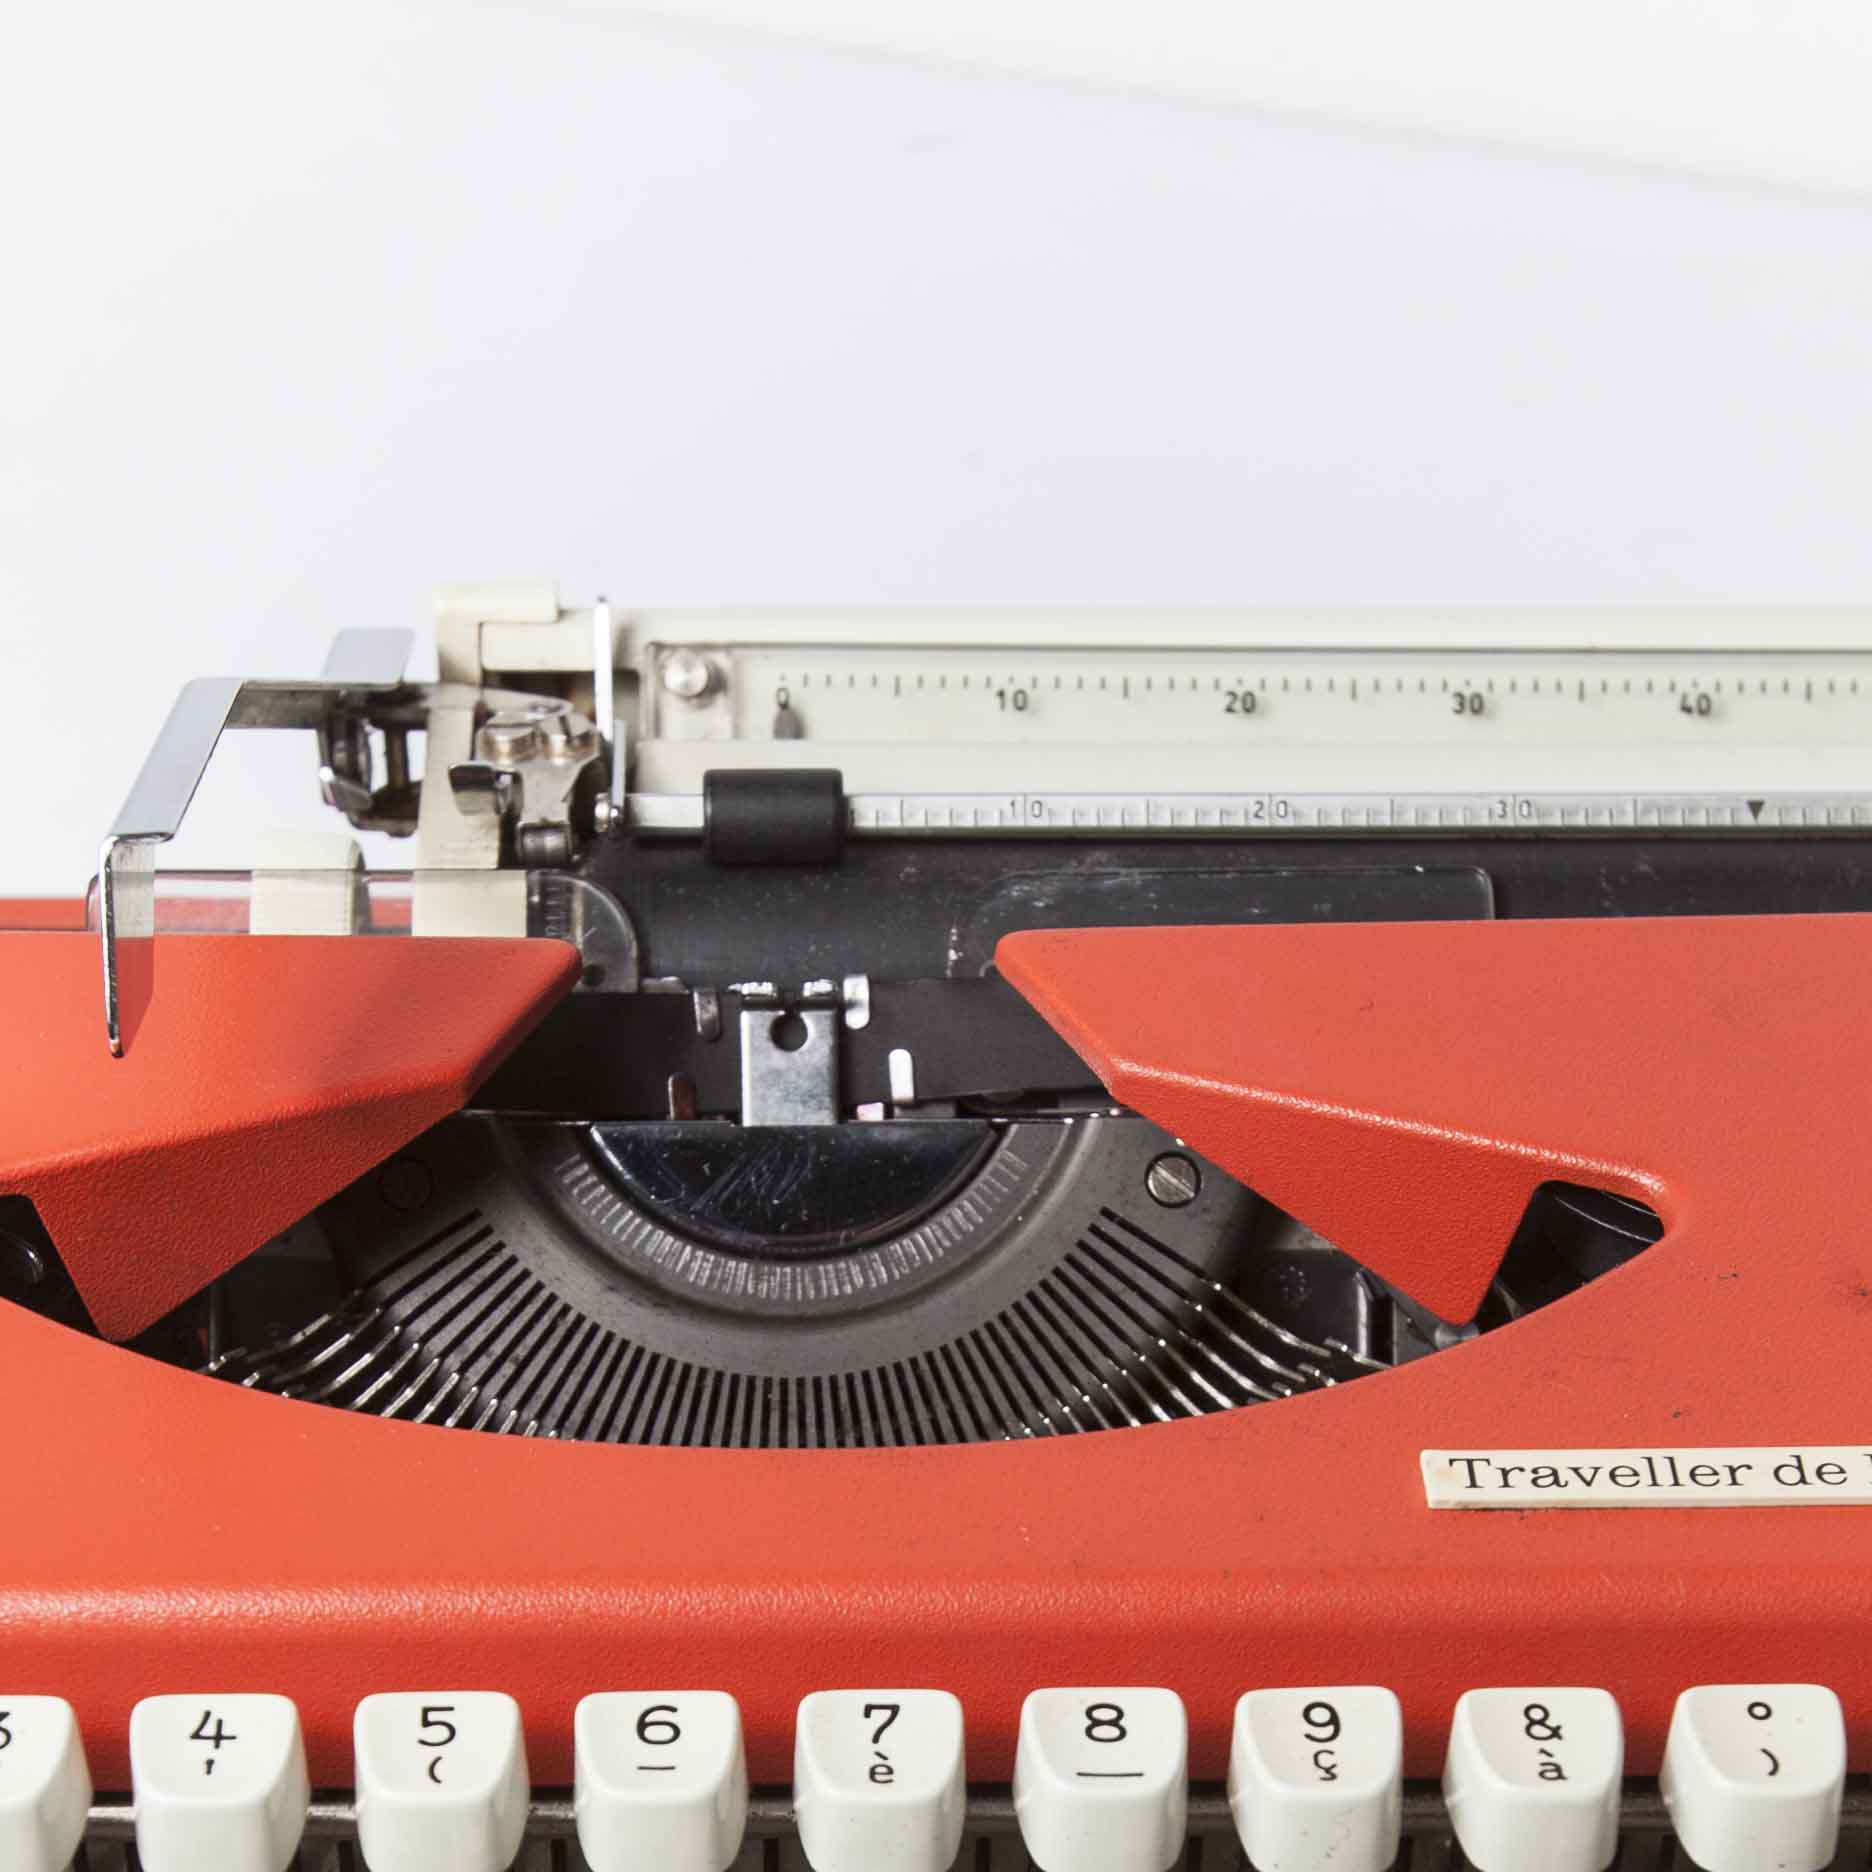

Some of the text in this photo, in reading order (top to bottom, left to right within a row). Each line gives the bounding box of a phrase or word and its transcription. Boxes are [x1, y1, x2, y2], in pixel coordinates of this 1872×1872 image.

[996, 689, 1029, 712] 10
[1224, 690, 1257, 715] 20
[1453, 691, 1486, 717] 30
[1679, 693, 1713, 717] 40
[1253, 801, 1288, 818] 20
[1497, 799, 1532, 820] 30
[1448, 1456, 1753, 1489] Traveller
[1772, 1454, 1848, 1487] de
[189, 1709, 238, 1750] 4
[417, 1705, 457, 1747] 5
[636, 1704, 681, 1746] 6
[863, 1703, 901, 1745] 7
[1084, 1702, 1128, 1744] 8
[1302, 1701, 1341, 1744] 9
[1523, 1703, 1563, 1742] &
[428, 1756, 443, 1784] (
[868, 1751, 895, 1785] è
[1312, 1749, 1338, 1782] ç
[1537, 1747, 1568, 1782] à
[1760, 1748, 1780, 1777] )
